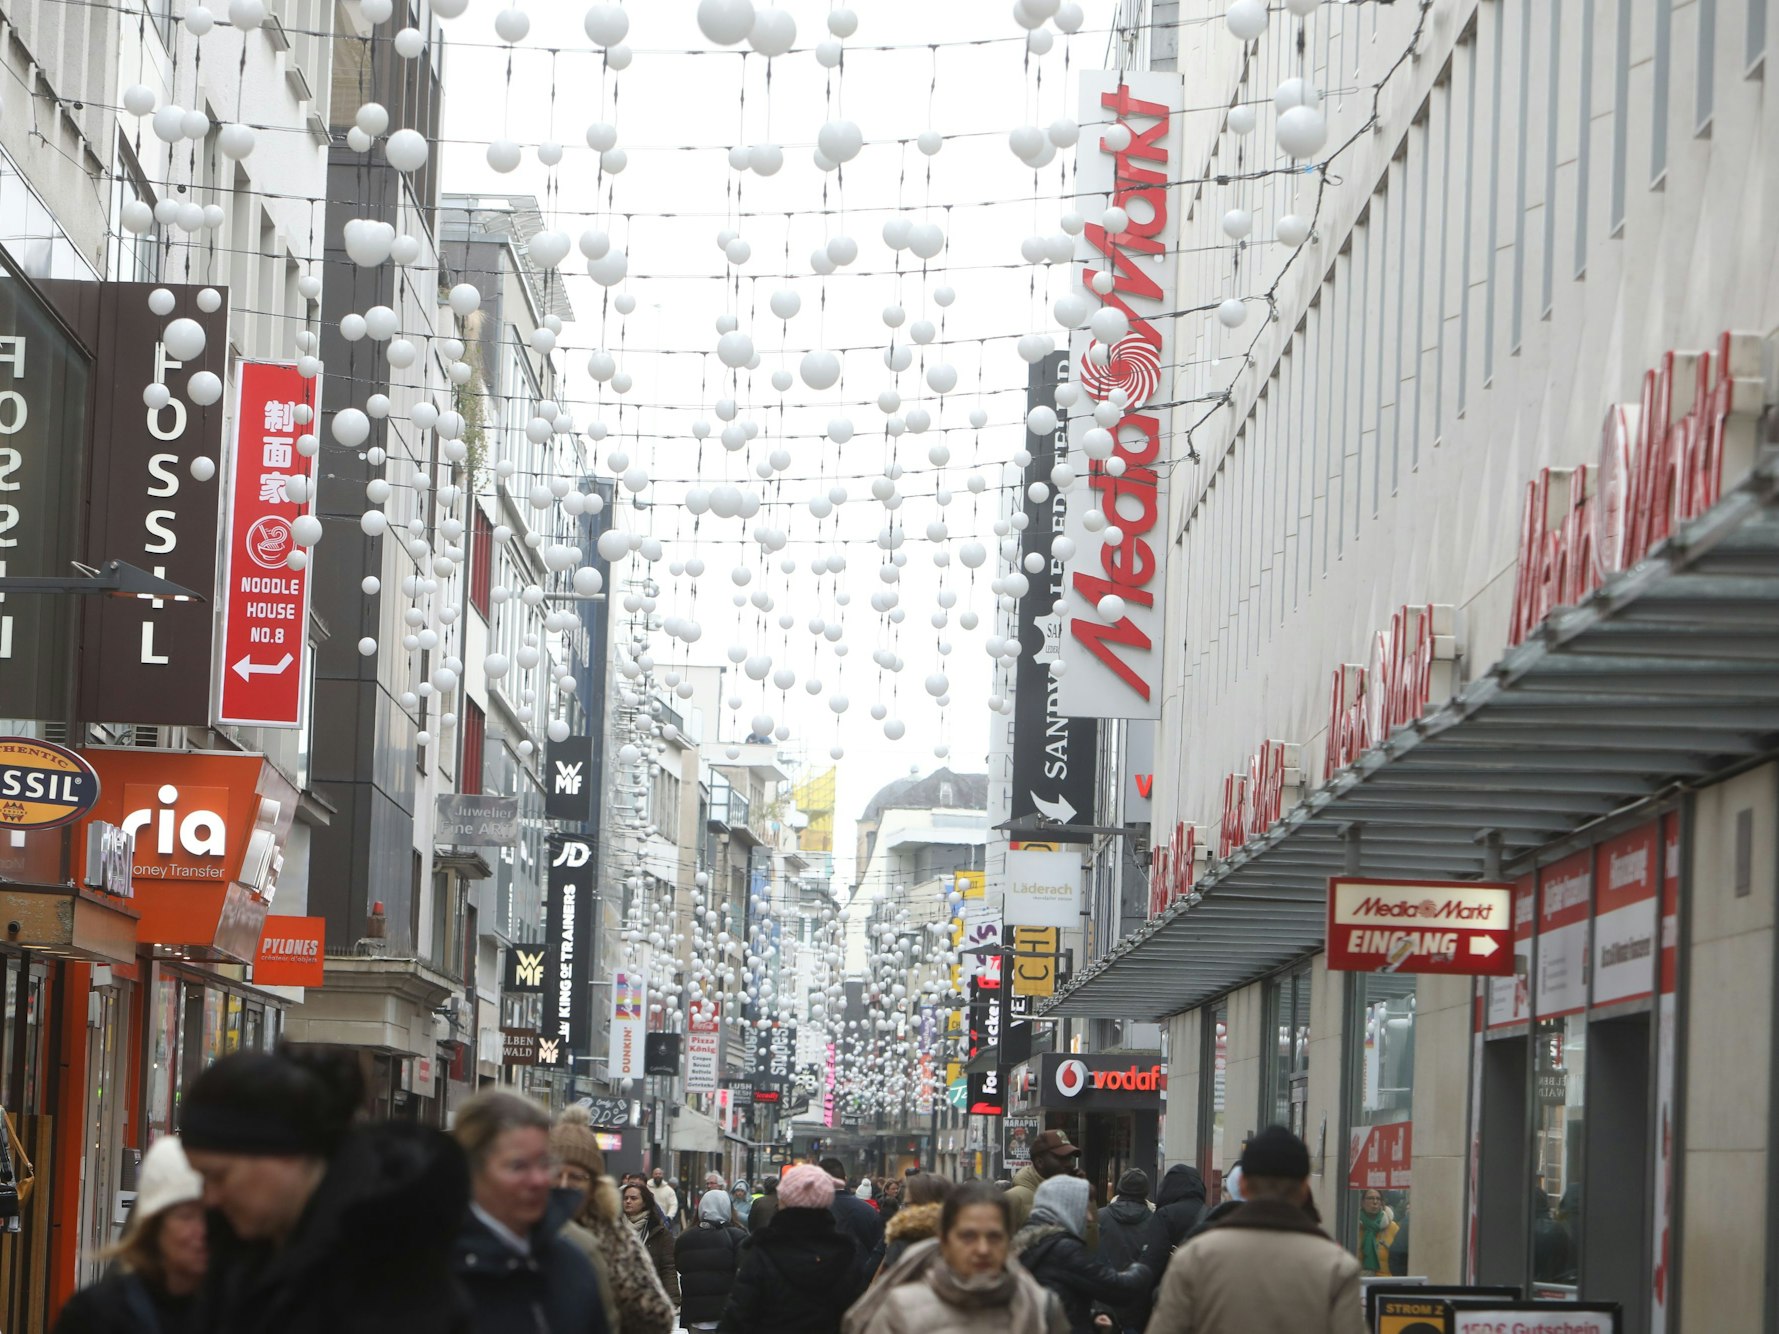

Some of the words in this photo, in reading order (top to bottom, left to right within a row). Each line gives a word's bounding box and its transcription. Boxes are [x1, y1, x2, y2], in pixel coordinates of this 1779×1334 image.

[241, 577, 299, 595] NOODLE
[247, 601, 295, 620] HOUSE
[250, 627, 284, 643] NO.8
[0, 746, 68, 768] HENTIC
[555, 761, 583, 795] WMF
[122, 784, 226, 856] ria
[455, 806, 513, 818] Juwelier
[441, 821, 473, 835] Fine
[553, 842, 591, 868] JD
[133, 864, 167, 878] oney
[170, 864, 225, 878] Transfer
[1013, 882, 1073, 895] Läderach
[1352, 897, 1421, 918] Media
[1433, 900, 1493, 920] Markt
[560, 884, 576, 962] TRAINERS
[262, 938, 319, 956] PYLONES
[515, 950, 545, 986] WMF
[560, 963, 572, 978] OF
[559, 980, 573, 1018] KING
[984, 998, 999, 1046] ocker
[503, 1048, 533, 1057] WALD
[538, 1038, 560, 1063] WMF
[689, 1046, 716, 1054] König
[1386, 1303, 1431, 1314] STROM
